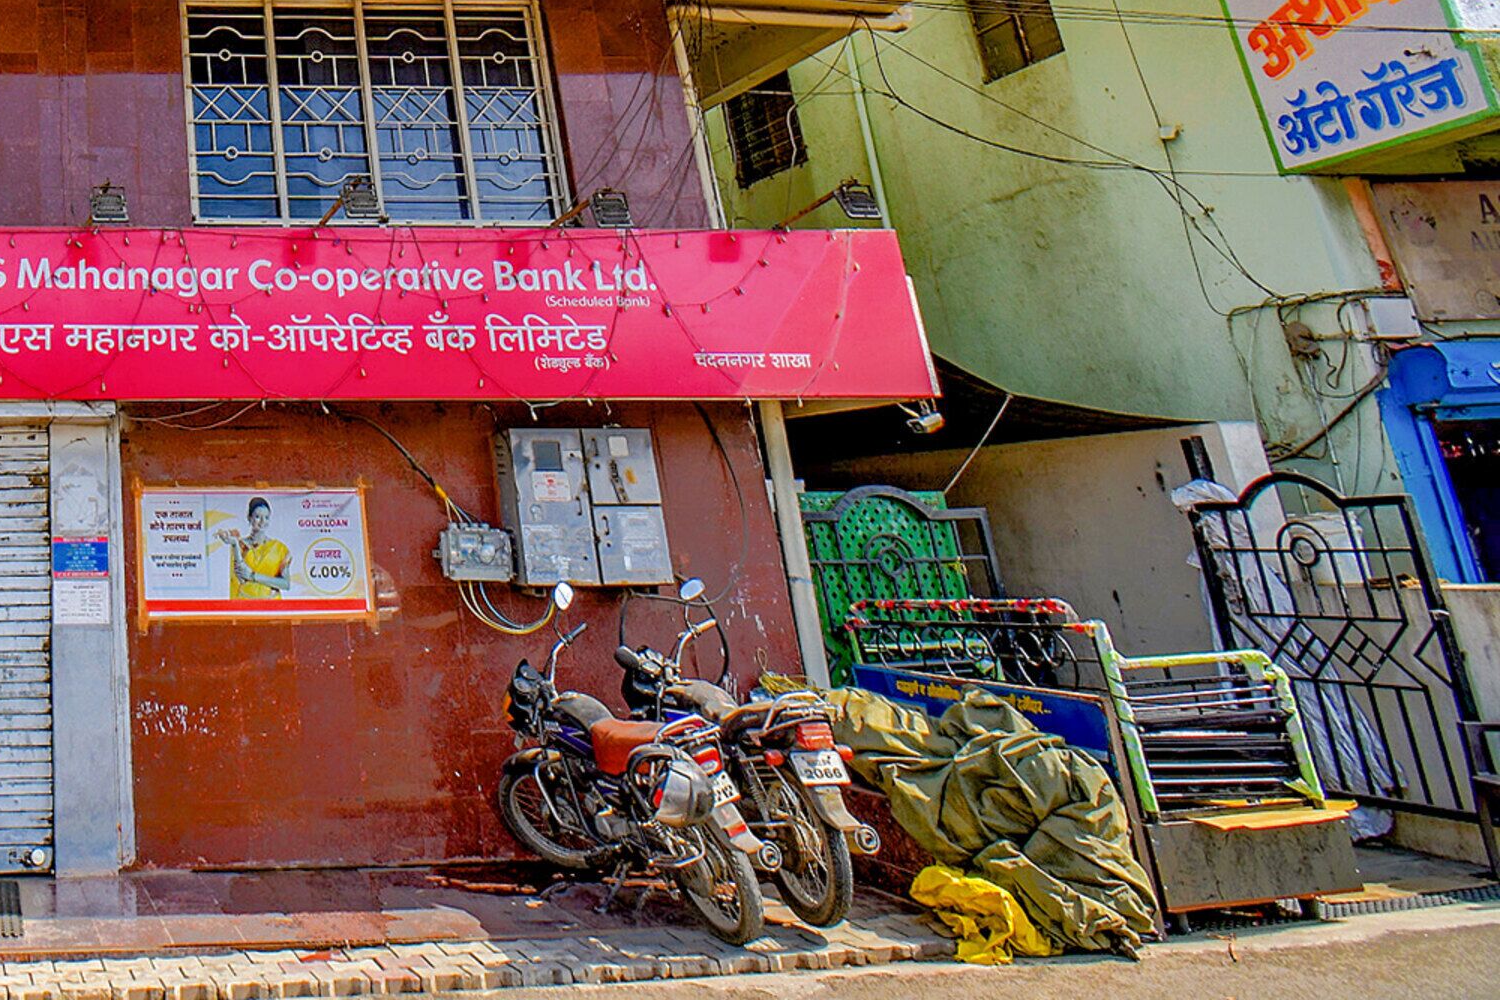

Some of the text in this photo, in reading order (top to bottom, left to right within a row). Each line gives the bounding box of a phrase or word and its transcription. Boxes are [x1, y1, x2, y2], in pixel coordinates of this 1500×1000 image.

[17, 258, 239, 297] Mahanagar
[249, 260, 483, 297] Co-operative
[493, 261, 587, 291] Bank
[593, 259, 657, 291] Ltd.
[545, 295, 650, 307] (Scheduled Bank)
[63, 324, 198, 355] महानगर
[422, 311, 476, 351] बँक
[485, 313, 607, 351] लिमिटेड
[768, 352, 811, 368] शाखा
[298, 519, 348, 527] GOLD LOAN
[804, 766, 843, 780] 2066
